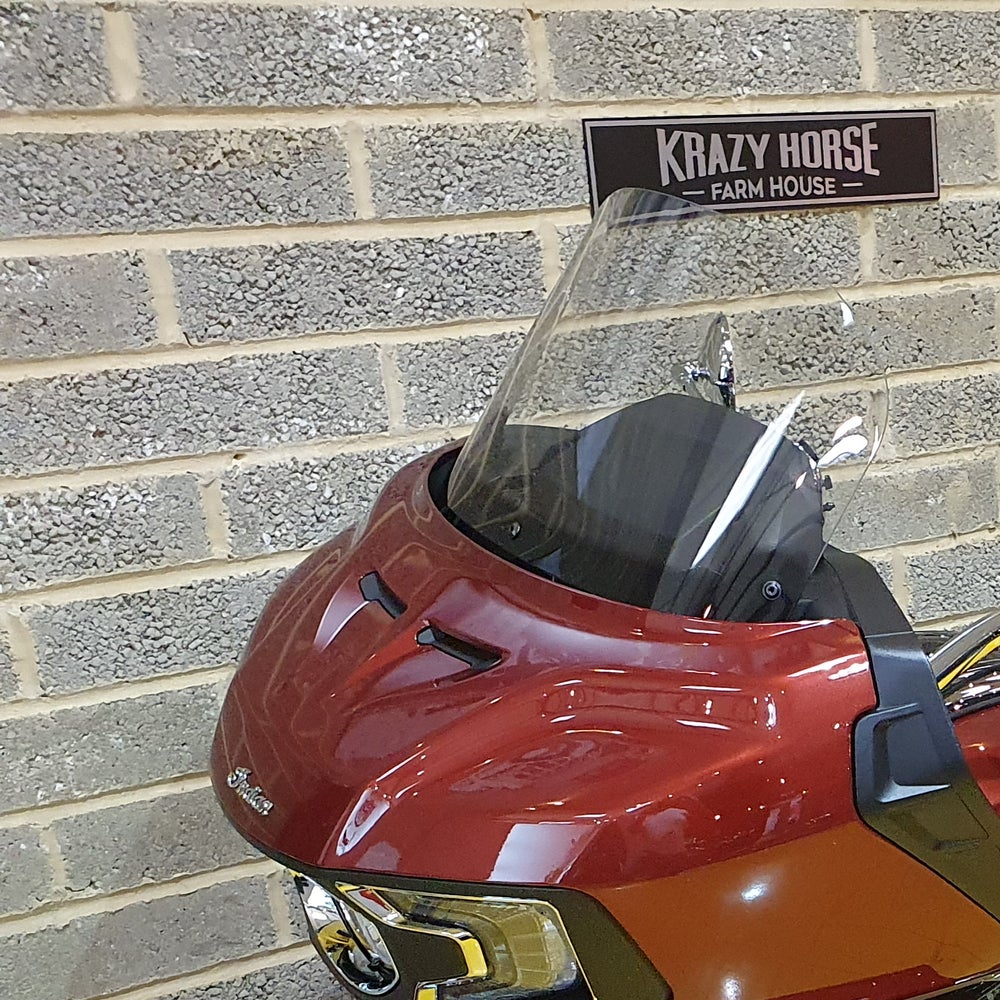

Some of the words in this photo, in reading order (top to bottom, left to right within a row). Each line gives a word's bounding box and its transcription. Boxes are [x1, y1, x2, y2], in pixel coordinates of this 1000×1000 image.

[655, 127, 770, 187] KRAZY
[778, 121, 880, 177] HORSE
[711, 177, 764, 200] FARM
[769, 176, 837, 197] HOUSE
